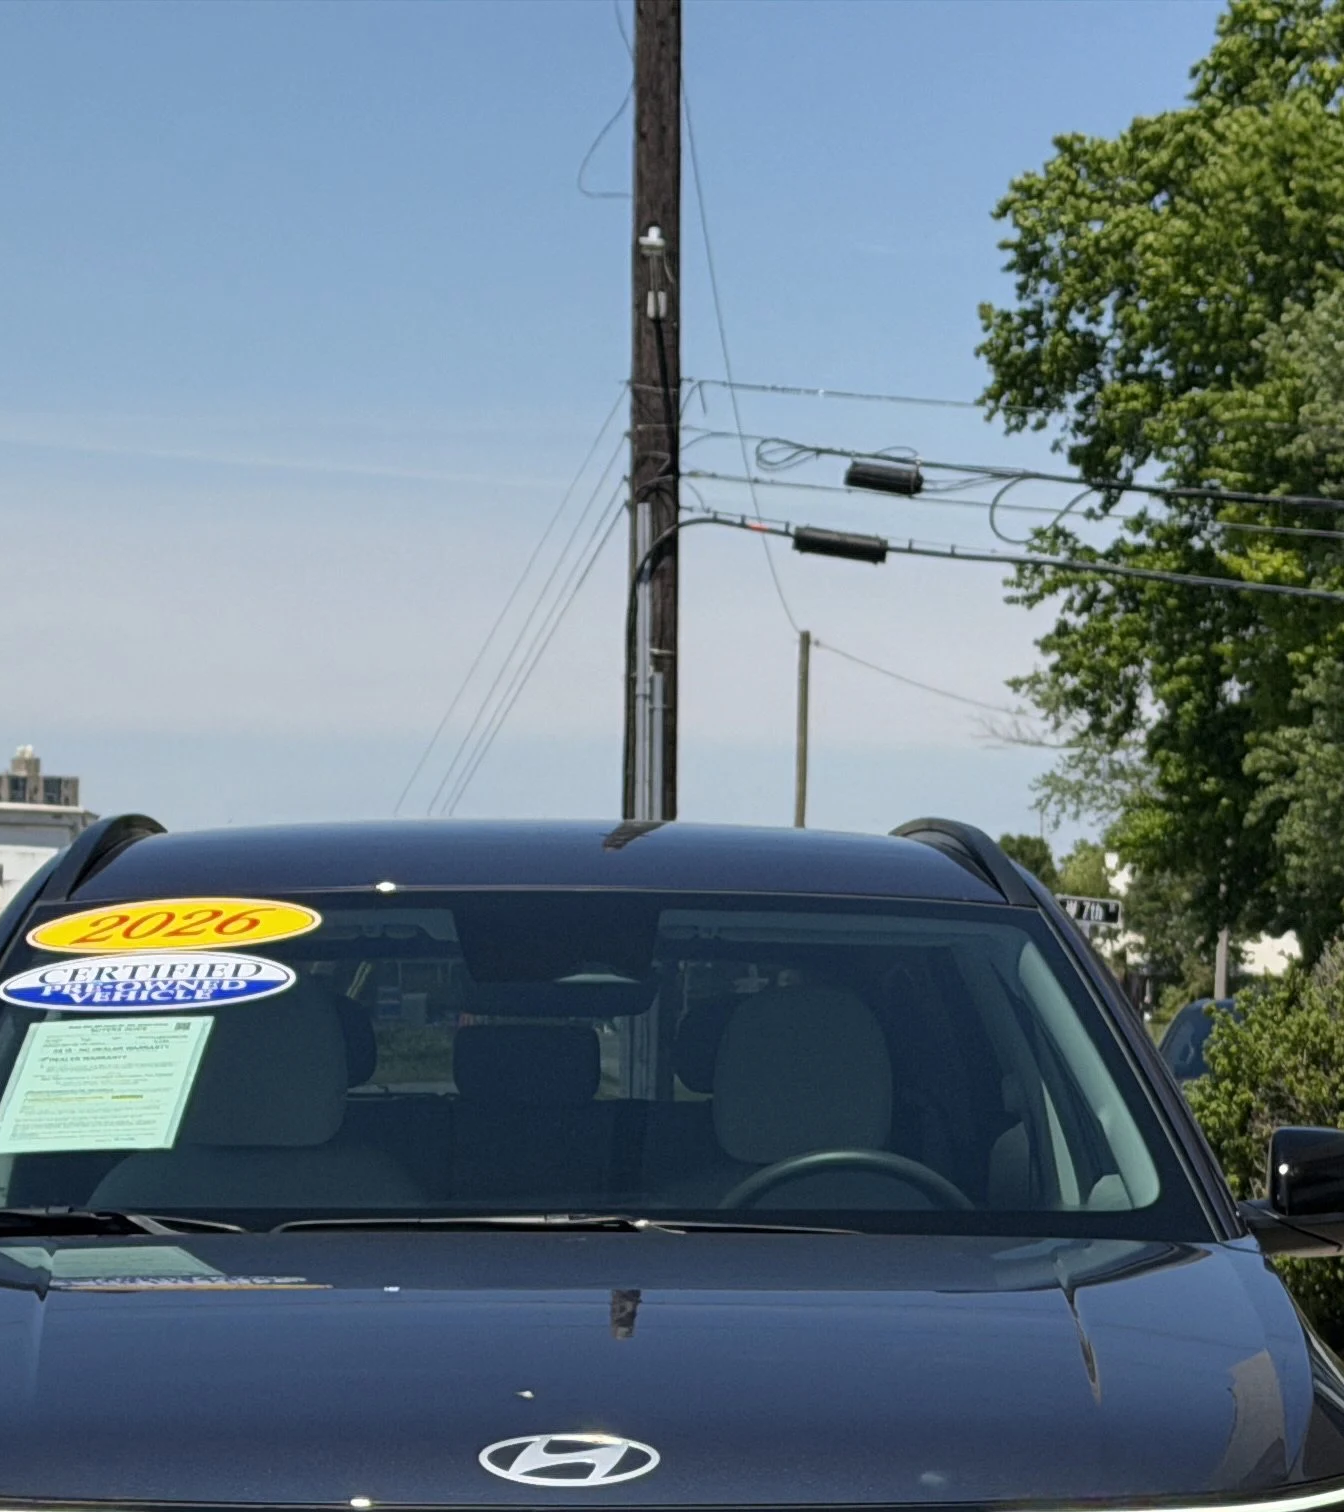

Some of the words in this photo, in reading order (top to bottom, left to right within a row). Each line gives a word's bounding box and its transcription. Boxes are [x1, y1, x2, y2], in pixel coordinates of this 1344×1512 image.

[1082, 901, 1104, 920] 7th
[67, 907, 277, 946] 2026
[38, 961, 263, 986] CERTIFIED
[40, 979, 247, 997] PRE-OWNED
[71, 988, 216, 1004] VEHICLE
